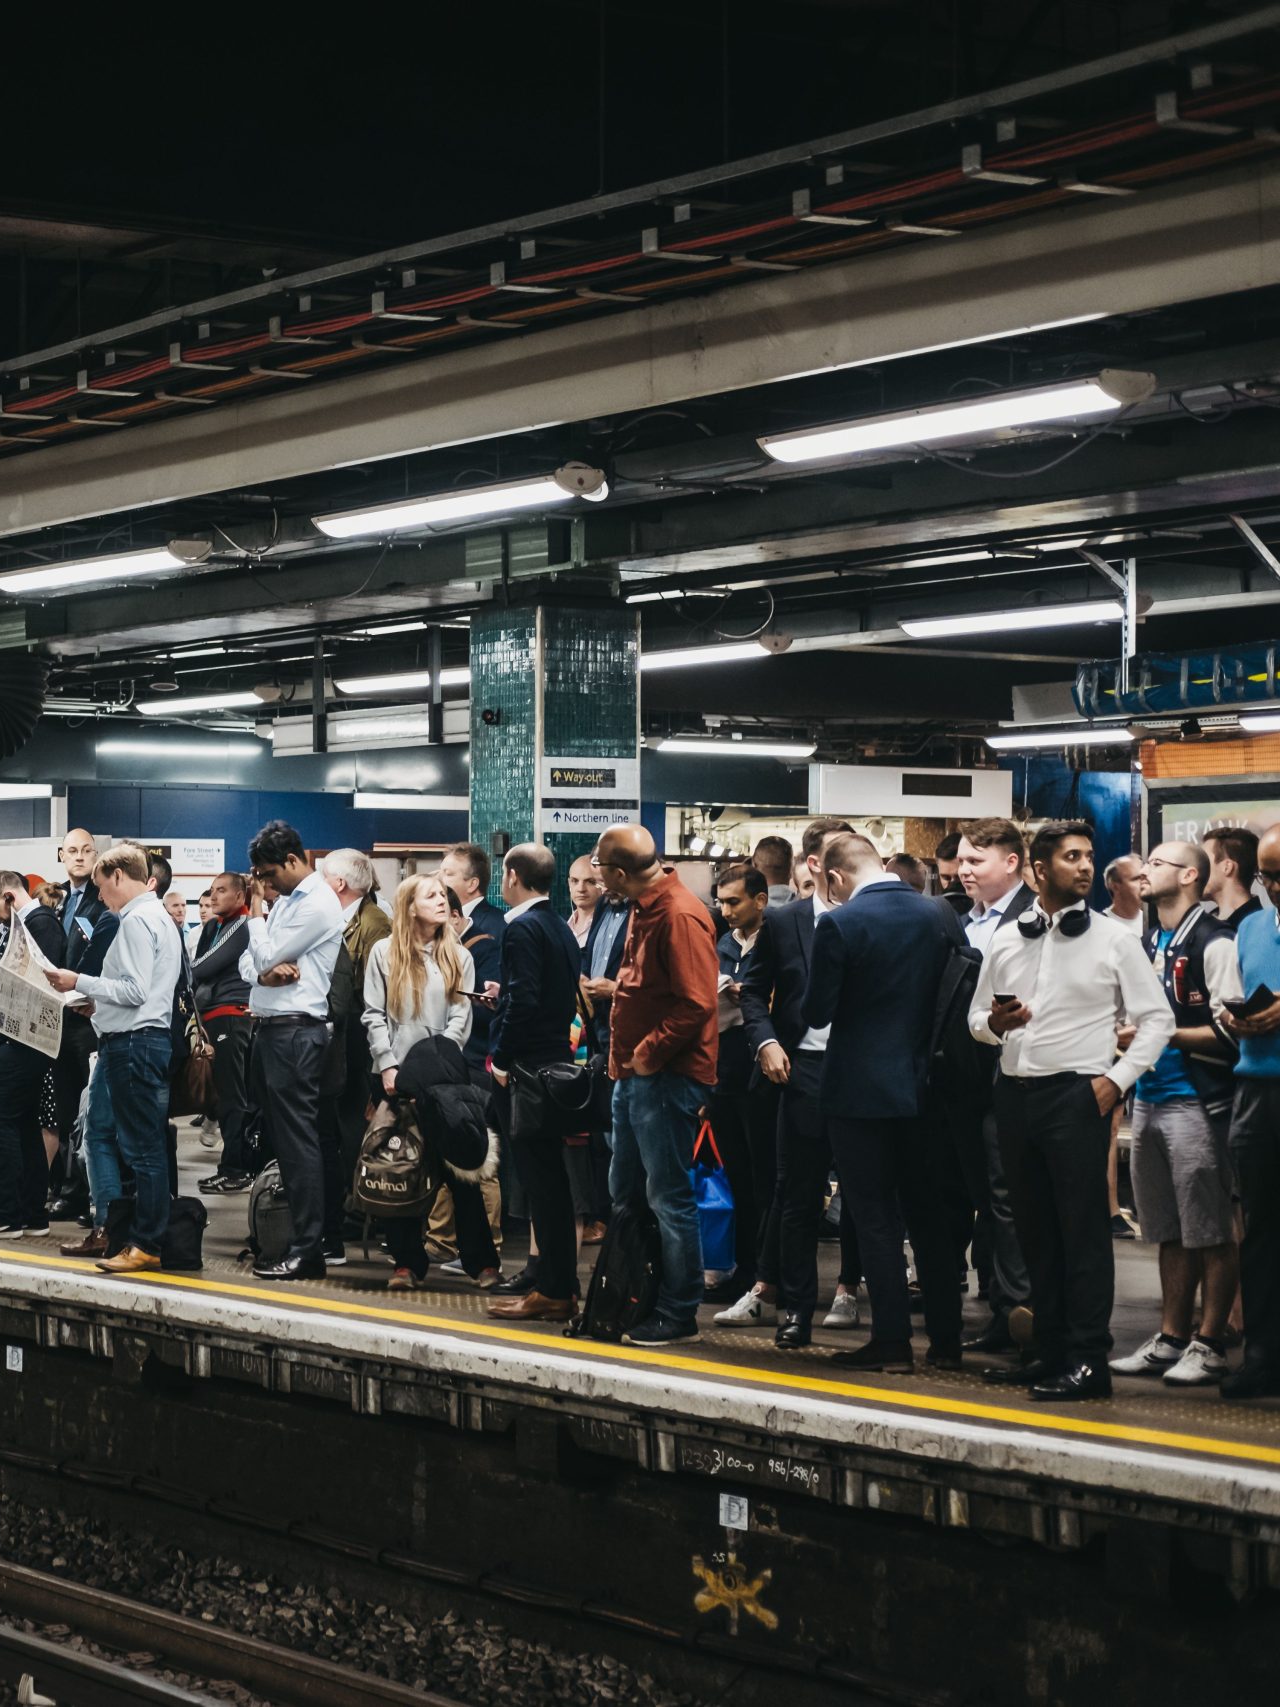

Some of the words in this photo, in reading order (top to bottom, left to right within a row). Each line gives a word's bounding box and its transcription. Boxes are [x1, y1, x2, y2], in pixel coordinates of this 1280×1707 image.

[563, 771, 584, 784] Way
[587, 773, 604, 783] out
[564, 812, 609, 823] Northern
[611, 812, 629, 823] line
[365, 1178, 408, 1192] animal
